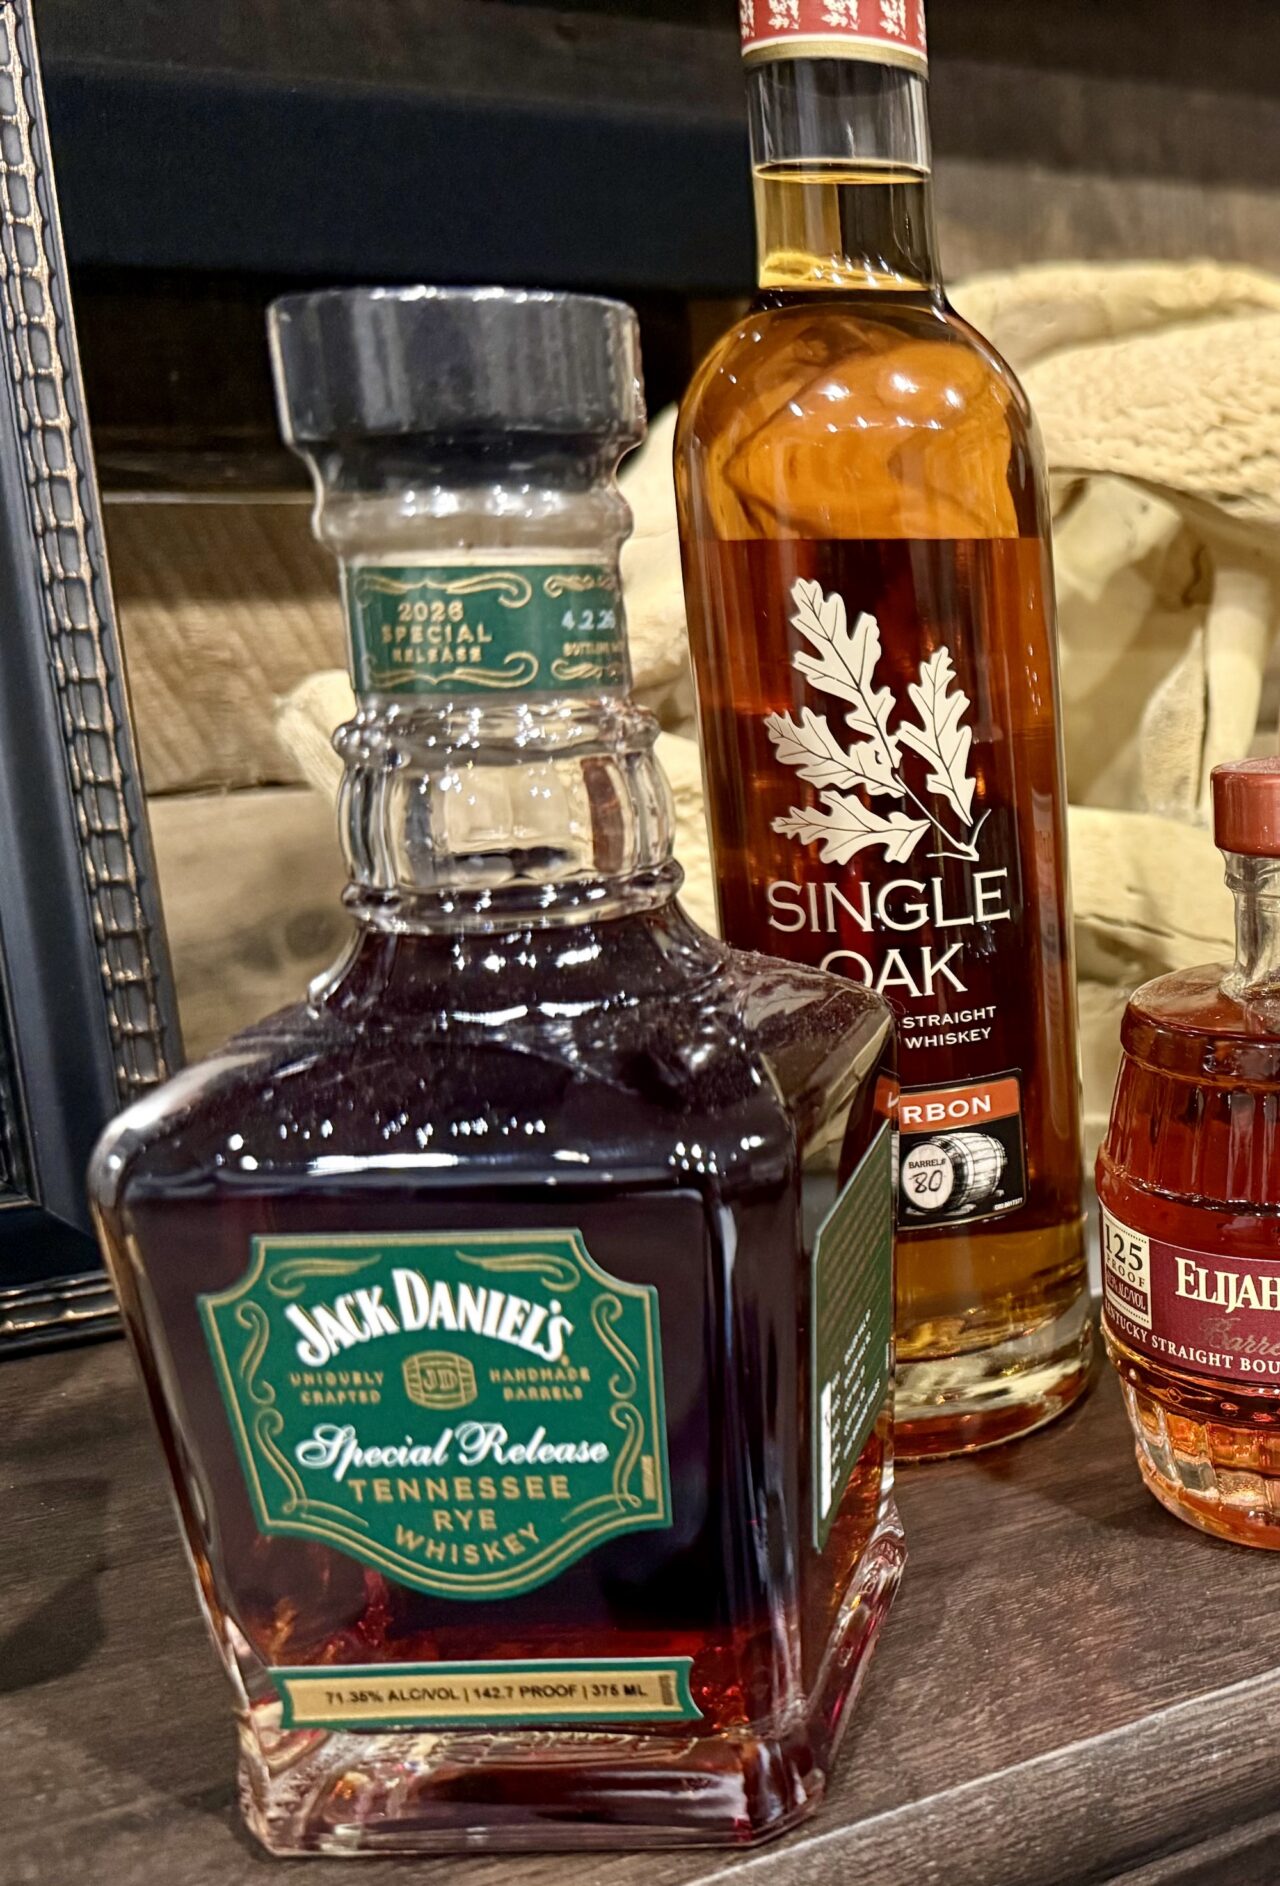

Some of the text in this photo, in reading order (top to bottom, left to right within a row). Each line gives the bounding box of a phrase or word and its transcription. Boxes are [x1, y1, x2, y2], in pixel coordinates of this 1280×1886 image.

[382, 623, 493, 645] SPECIAL
[393, 646, 482, 664] RELEASE
[766, 866, 1012, 933] SINGLE
[819, 942, 968, 998] OAK
[902, 1005, 998, 1029] STRAIGHT
[904, 1026, 993, 1050] WHISKEY
[909, 1169, 943, 1193] 80
[1105, 1223, 1144, 1271] 125
[1106, 1253, 1147, 1288] PROOF
[1118, 1280, 1147, 1312] ALC/VOL
[284, 1268, 575, 1367] JACK DANIEL'S
[1151, 1334, 1234, 1369] STRAIGHT
[289, 1366, 591, 1387] UNIQUELY HANDMADE
[301, 1385, 583, 1406] CRAFTED BARRELS
[295, 1420, 609, 1482] Special Release
[347, 1474, 571, 1503] TENNESSEE
[432, 1508, 498, 1532] RYE
[395, 1521, 540, 1566] WHISKEY
[388, 1686, 460, 1702] ALC/VOL
[519, 1684, 578, 1699] PROOF
[623, 1683, 649, 1697] ML
